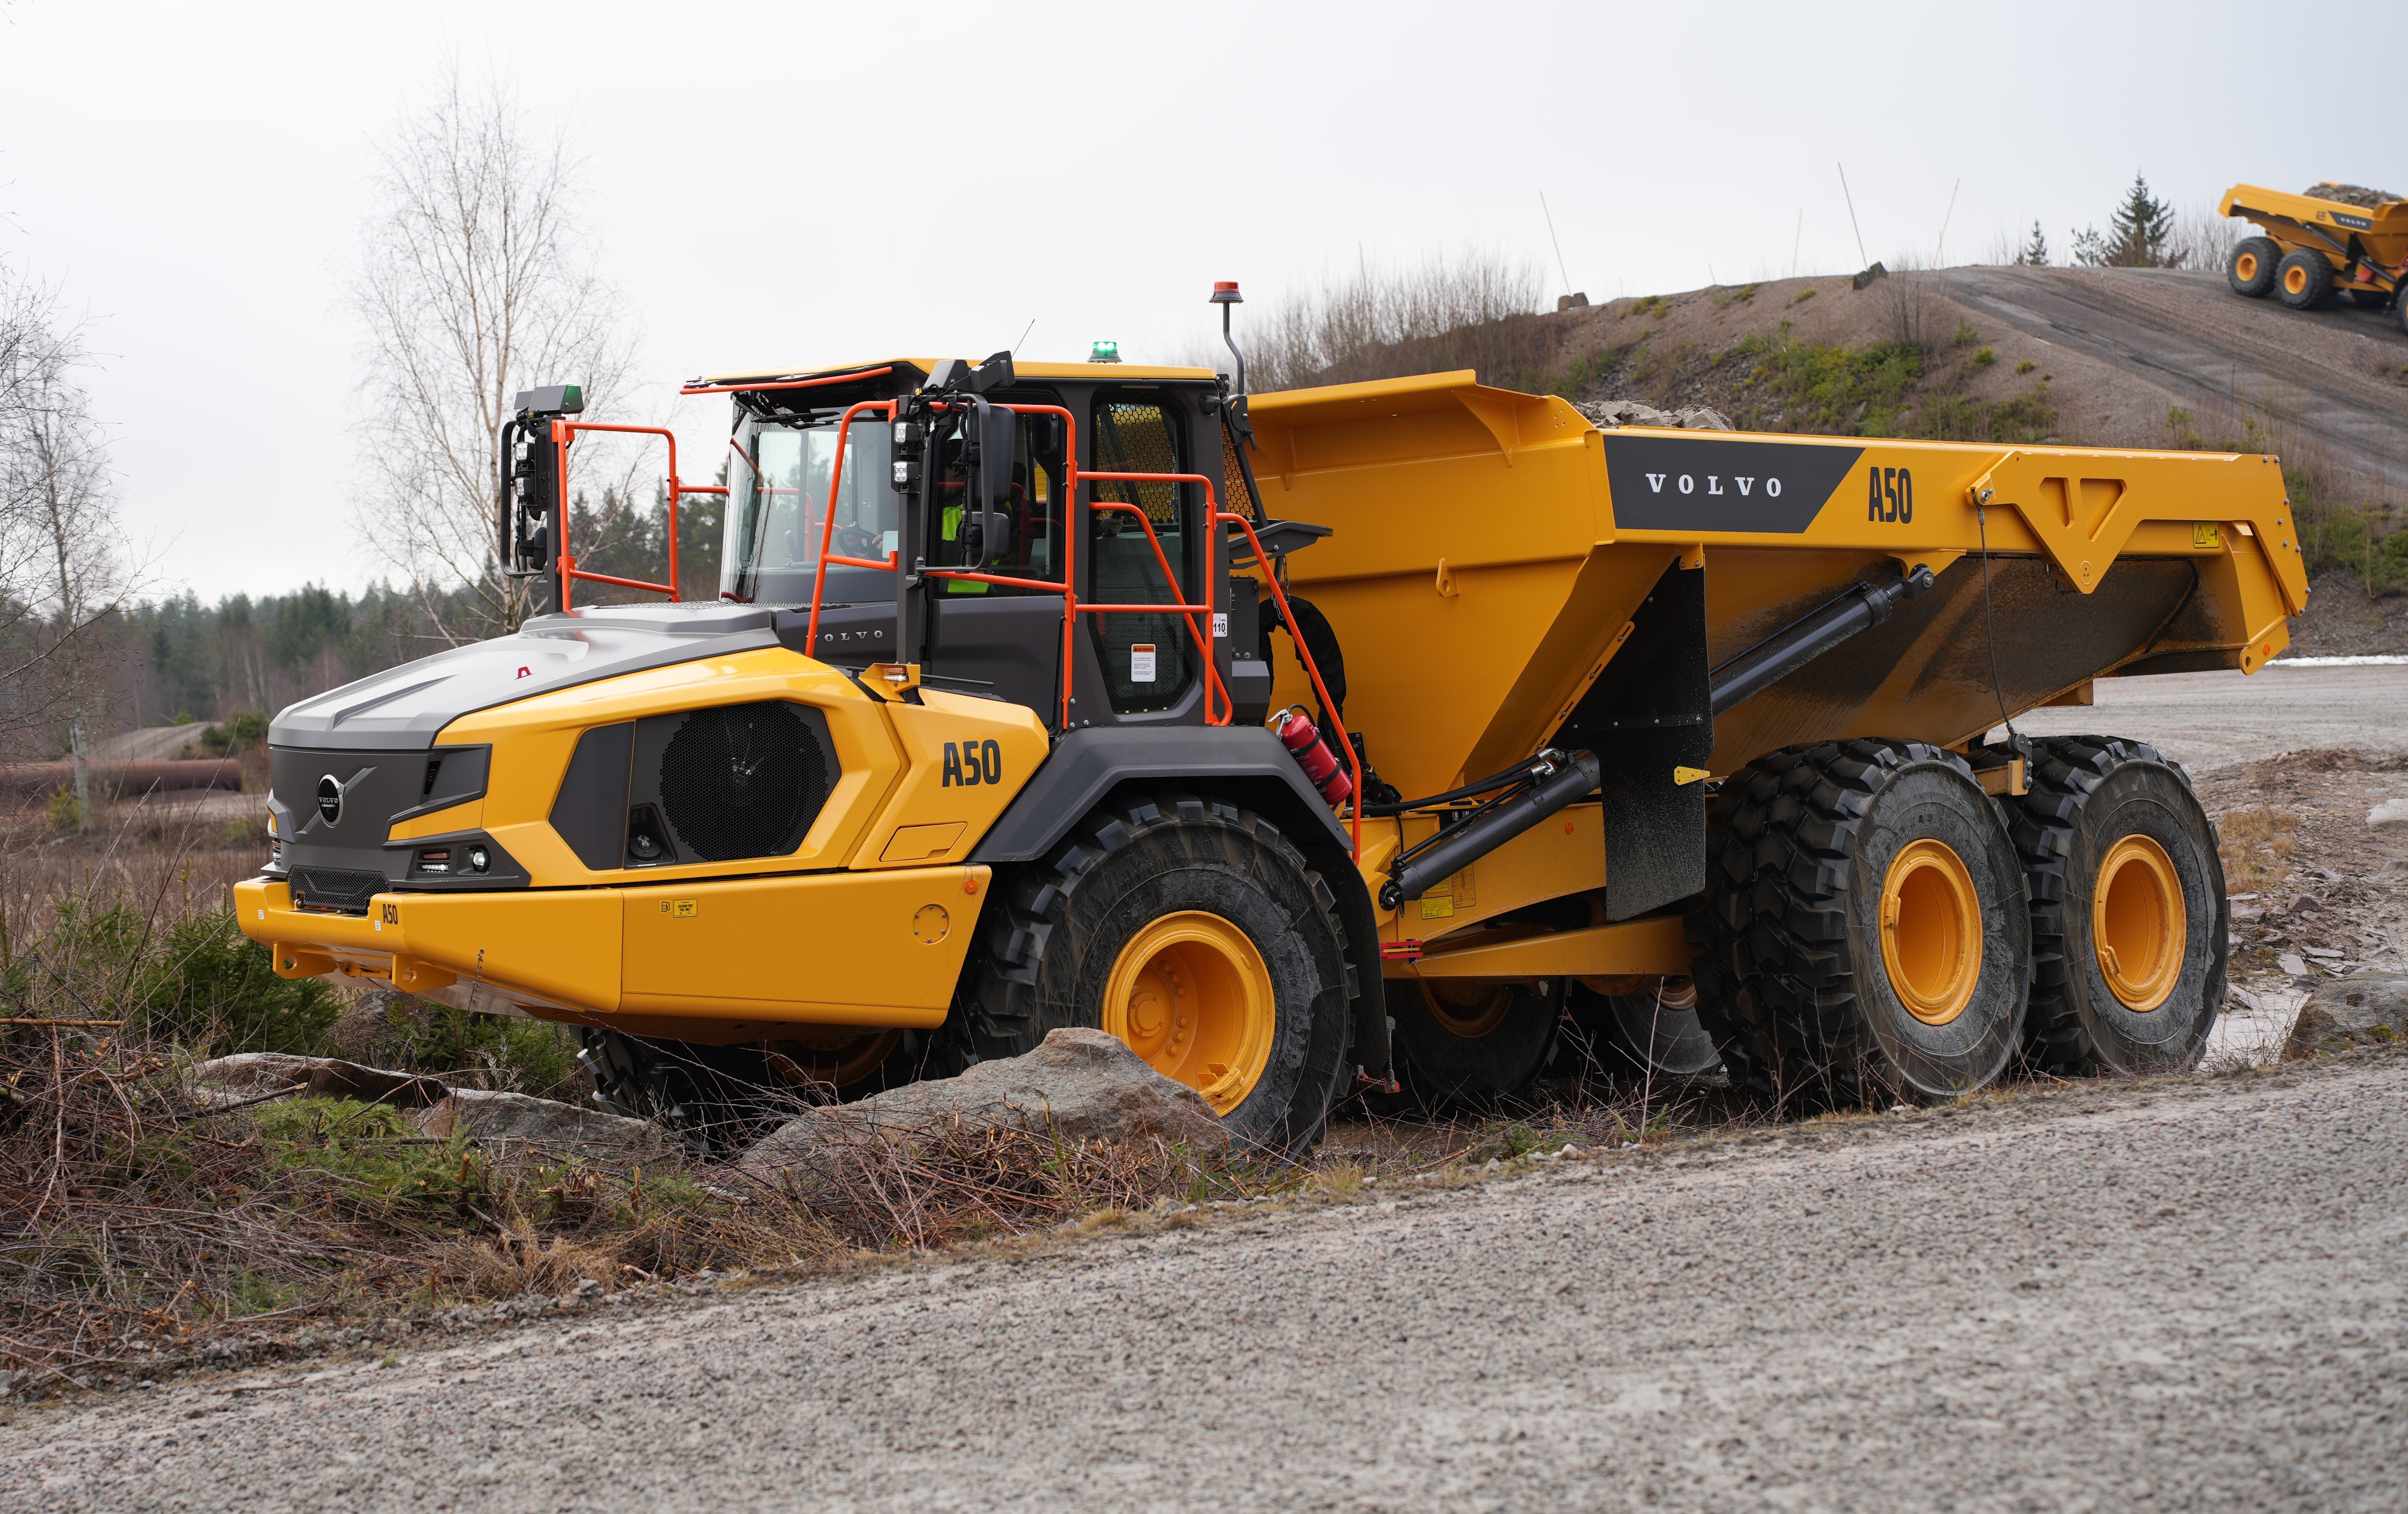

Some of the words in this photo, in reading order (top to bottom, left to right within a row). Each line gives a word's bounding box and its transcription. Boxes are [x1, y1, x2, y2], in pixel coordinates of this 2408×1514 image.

[1646, 473, 1782, 497] VOLVO
[1868, 467, 1912, 524] A50
[1213, 623, 1225, 632] 110
[942, 739, 1001, 787] A50
[383, 903, 398, 925] A50
